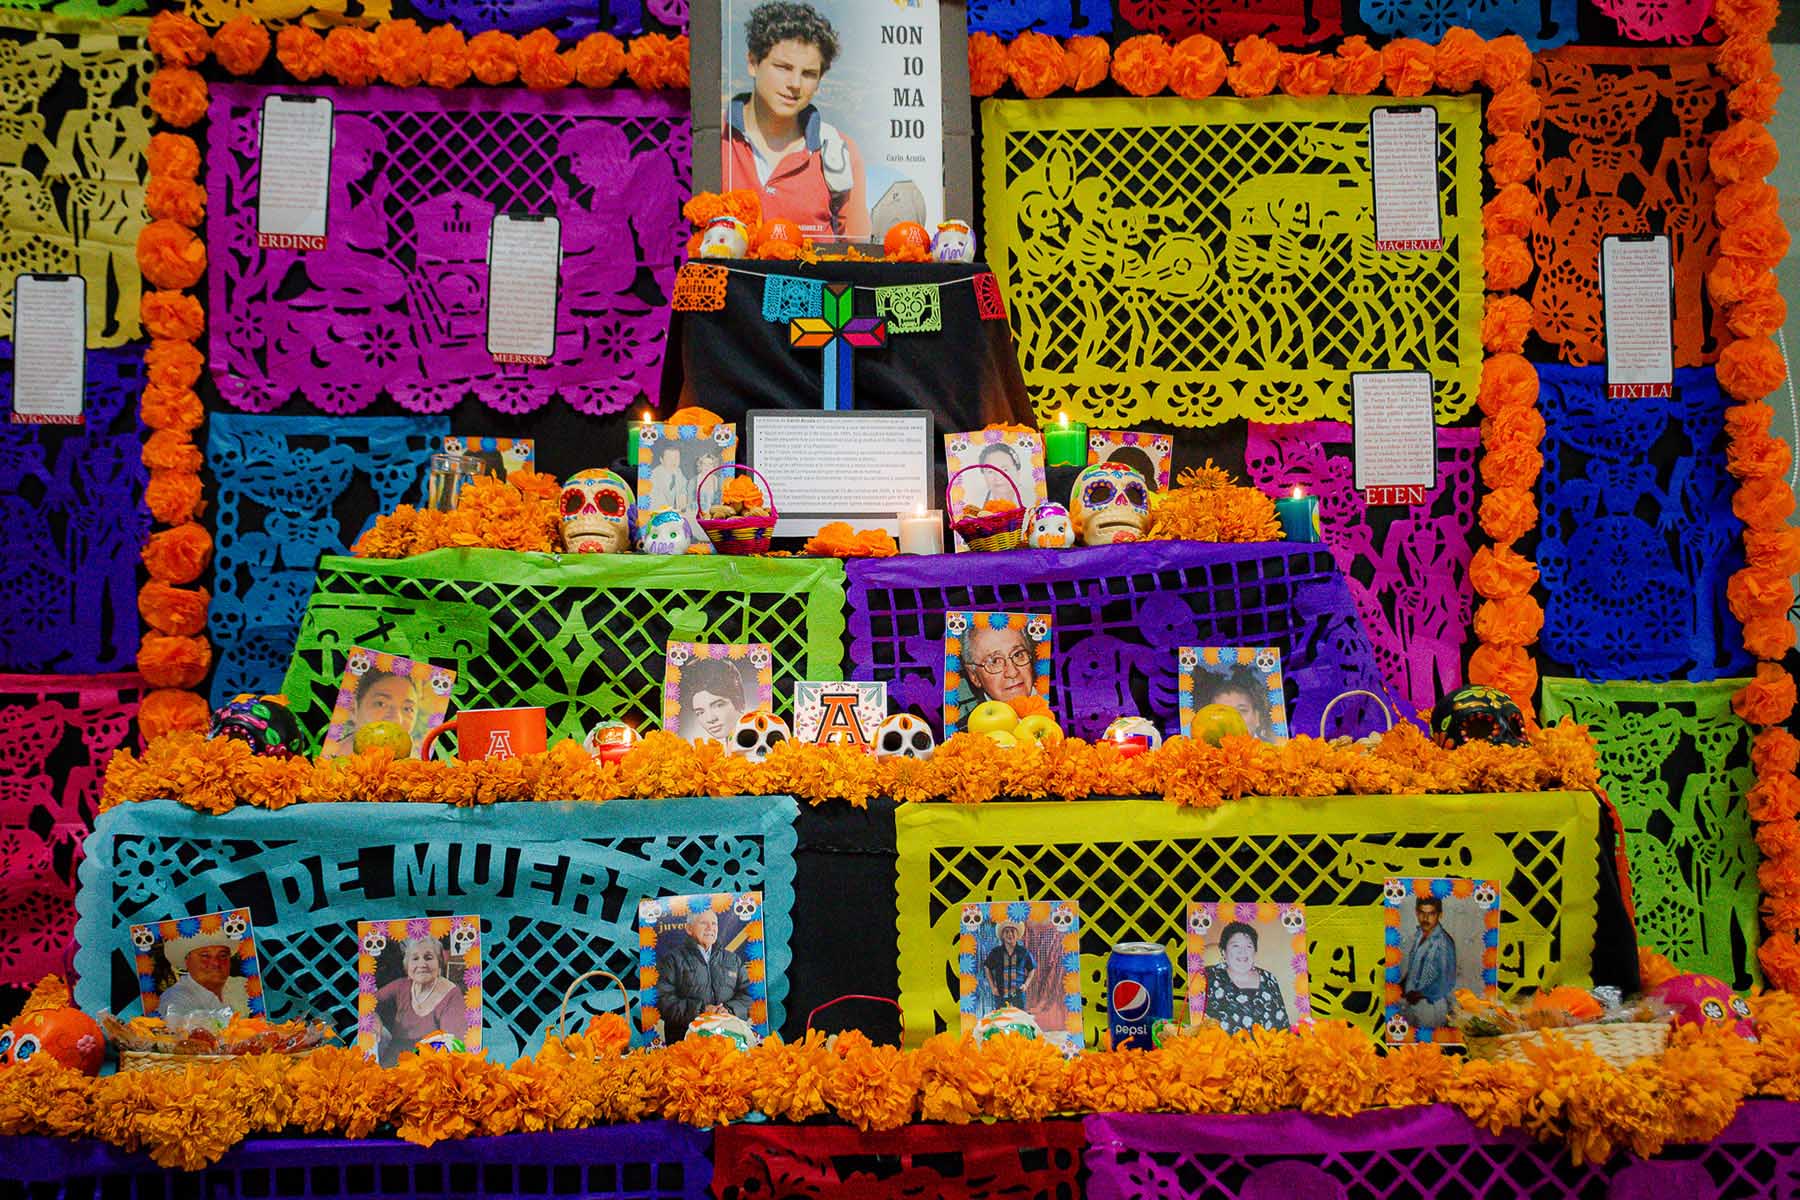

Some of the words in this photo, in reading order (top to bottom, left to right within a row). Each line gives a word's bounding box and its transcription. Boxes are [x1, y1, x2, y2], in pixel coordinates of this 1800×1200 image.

[881, 25, 923, 45] NON
[904, 56, 924, 76] IO
[893, 87, 925, 107] MA
[890, 119, 925, 139] DIO
[258, 233, 325, 250] ERDING
[1376, 240, 1442, 251] MACERATA
[493, 353, 547, 366] MEERSSEN
[1609, 384, 1668, 399] TIXTLA
[10, 413, 81, 425] AVIGNONE
[1365, 486, 1423, 505] ETEN
[810, 693, 871, 746] A
[268, 852, 366, 922] DE
[1115, 1024, 1148, 1037] pepsi
